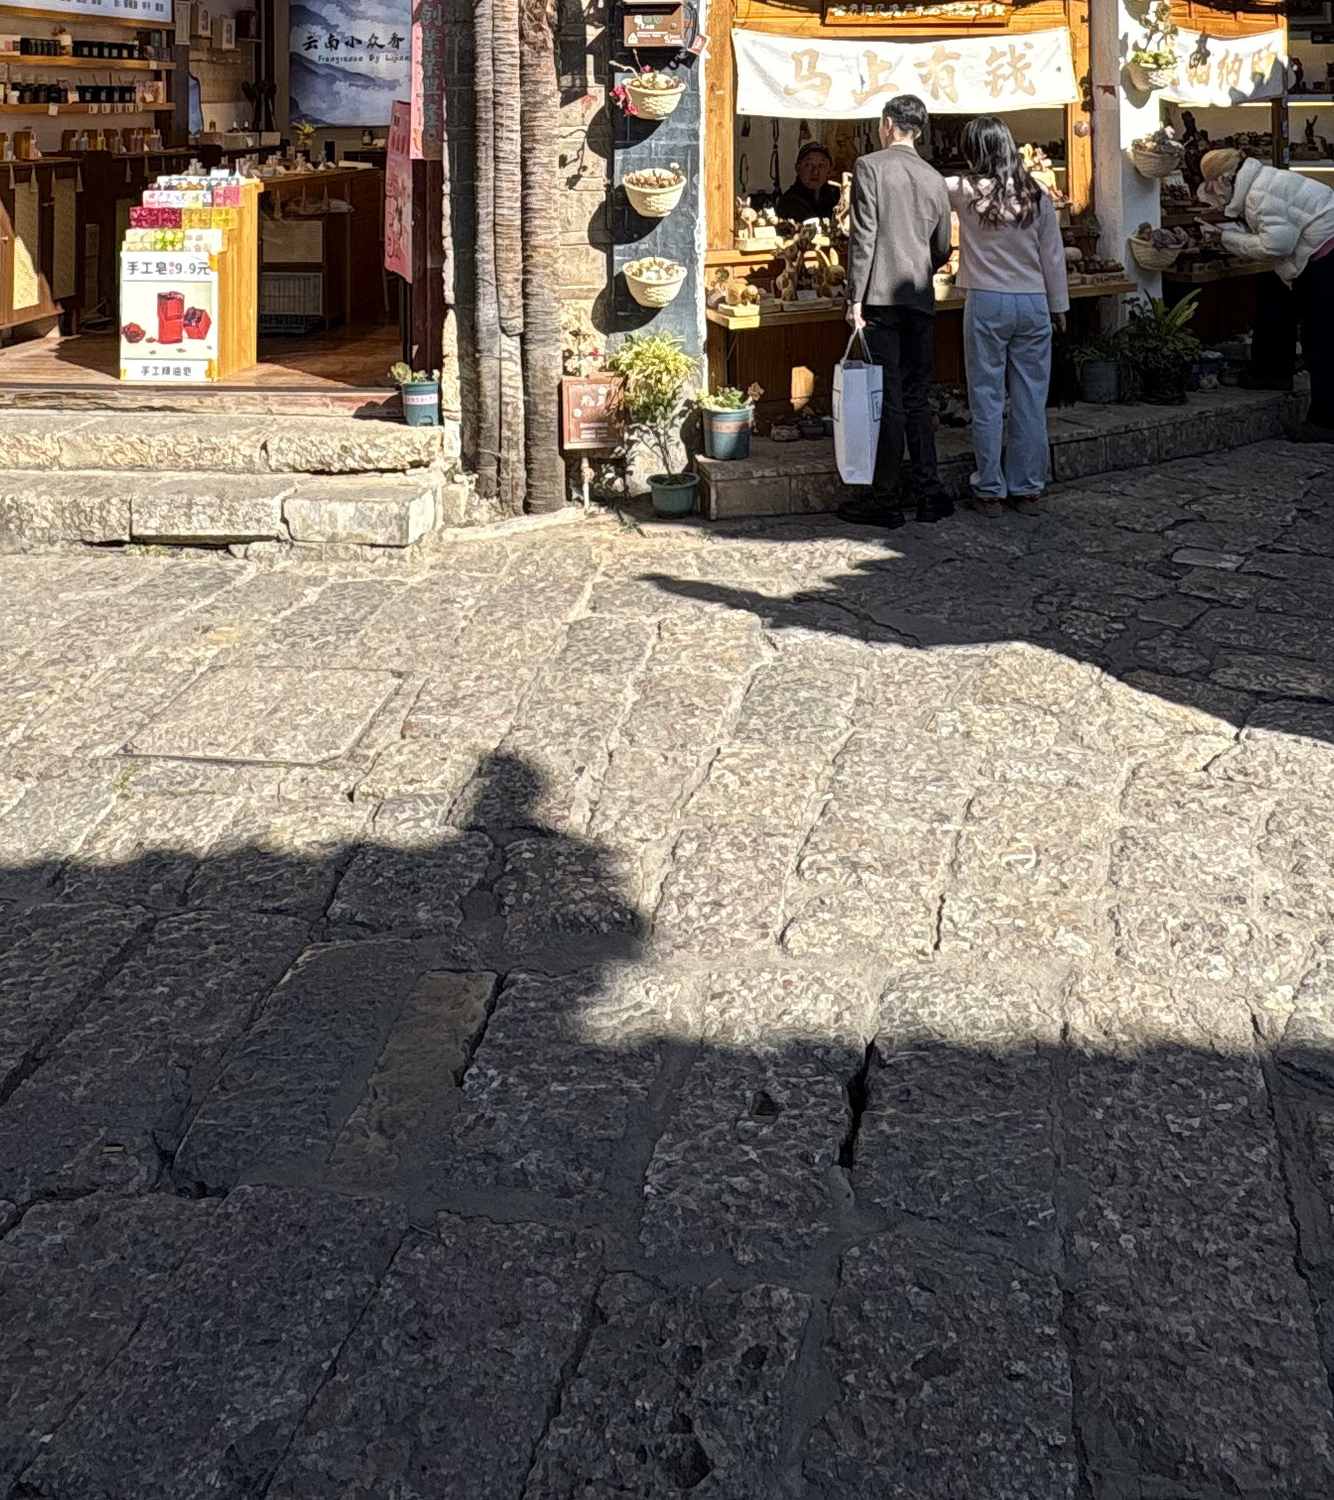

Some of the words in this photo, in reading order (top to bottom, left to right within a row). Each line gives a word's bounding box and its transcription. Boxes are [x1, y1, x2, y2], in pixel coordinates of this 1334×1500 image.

[302, 32, 406, 51] 云南小众香
[784, 41, 1038, 105] 马上有钱
[126, 260, 168, 276] 手工皂
[175, 261, 211, 276] 9.9元
